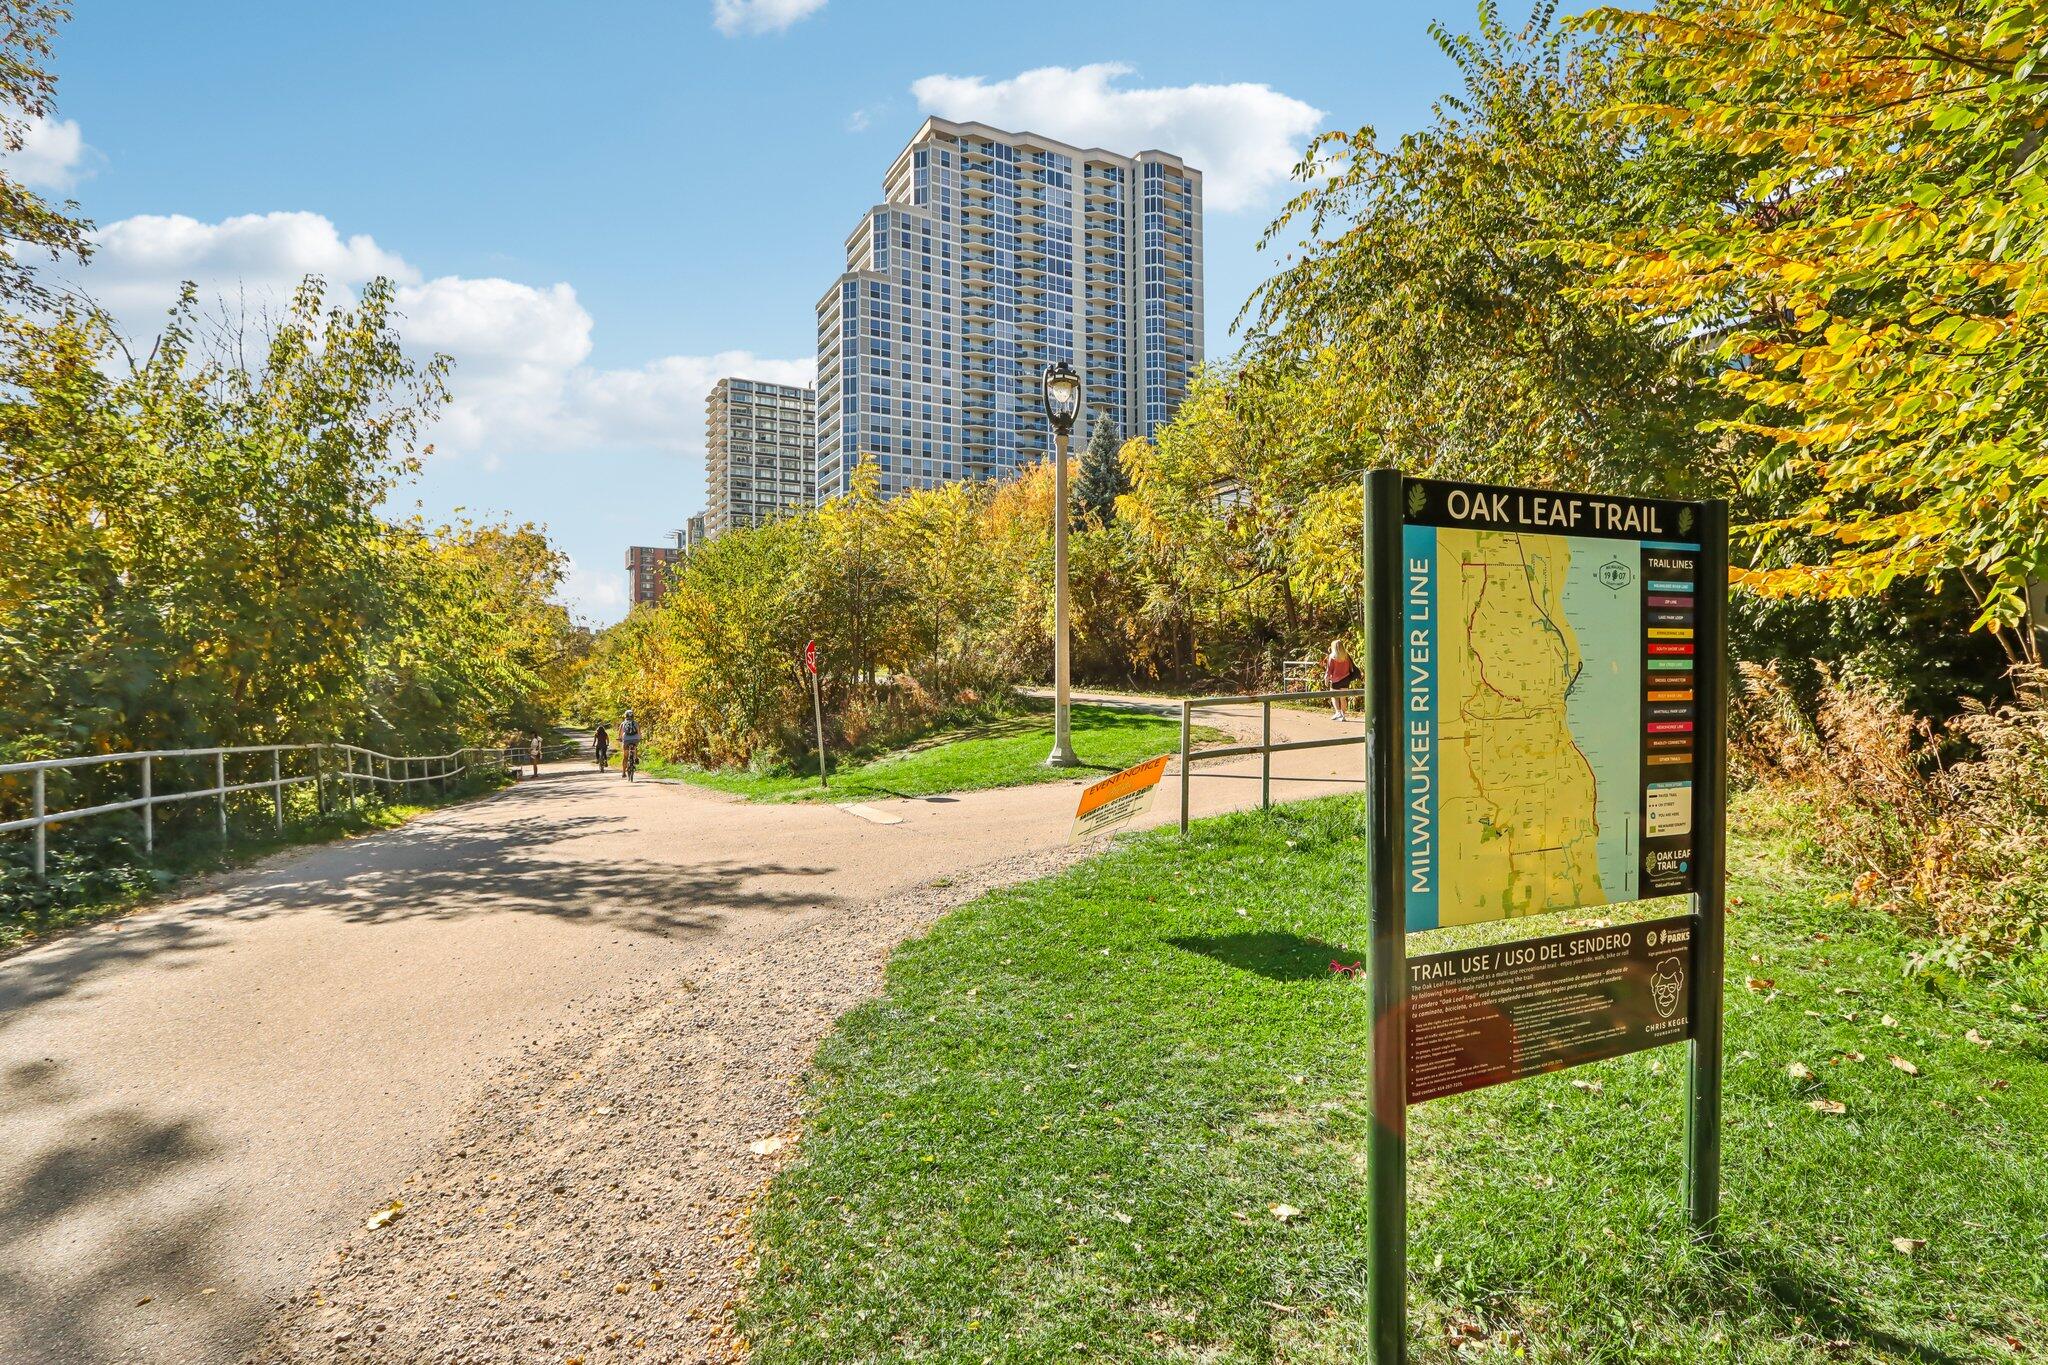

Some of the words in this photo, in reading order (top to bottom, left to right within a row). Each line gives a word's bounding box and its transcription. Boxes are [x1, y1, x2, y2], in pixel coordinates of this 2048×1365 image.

[1448, 490, 1510, 523] OAK
[1518, 496, 1582, 528] LEAF
[1590, 502, 1662, 534] TRAIL
[1648, 558, 1670, 568] TRAIL
[1672, 560, 1693, 569] LINES
[1410, 558, 1428, 620] LINE
[1411, 630, 1429, 712] RIVER
[1090, 774, 1120, 795] EVENT
[1123, 760, 1160, 780] NOTICE
[1411, 720, 1430, 893] MILWAUKEE
[1657, 852, 1673, 860] OAK
[1674, 849, 1691, 859] LEAF
[1657, 861, 1678, 870] TRAIL
[1667, 930, 1690, 943] PARKS
[1410, 960, 1456, 982] TRAIL
[1461, 955, 1489, 974] USE
[1494, 952, 1500, 969] /
[1505, 948, 1535, 966] USO
[1540, 943, 1565, 960] DEL
[1569, 932, 1631, 956] SENDERO
[1462, 973, 1484, 982] designed
[1418, 990, 1442, 998] following
[1458, 984, 1474, 992] simple
[1645, 1022, 1665, 1032] CHRIS
[1667, 1017, 1688, 1027] KEGEL
